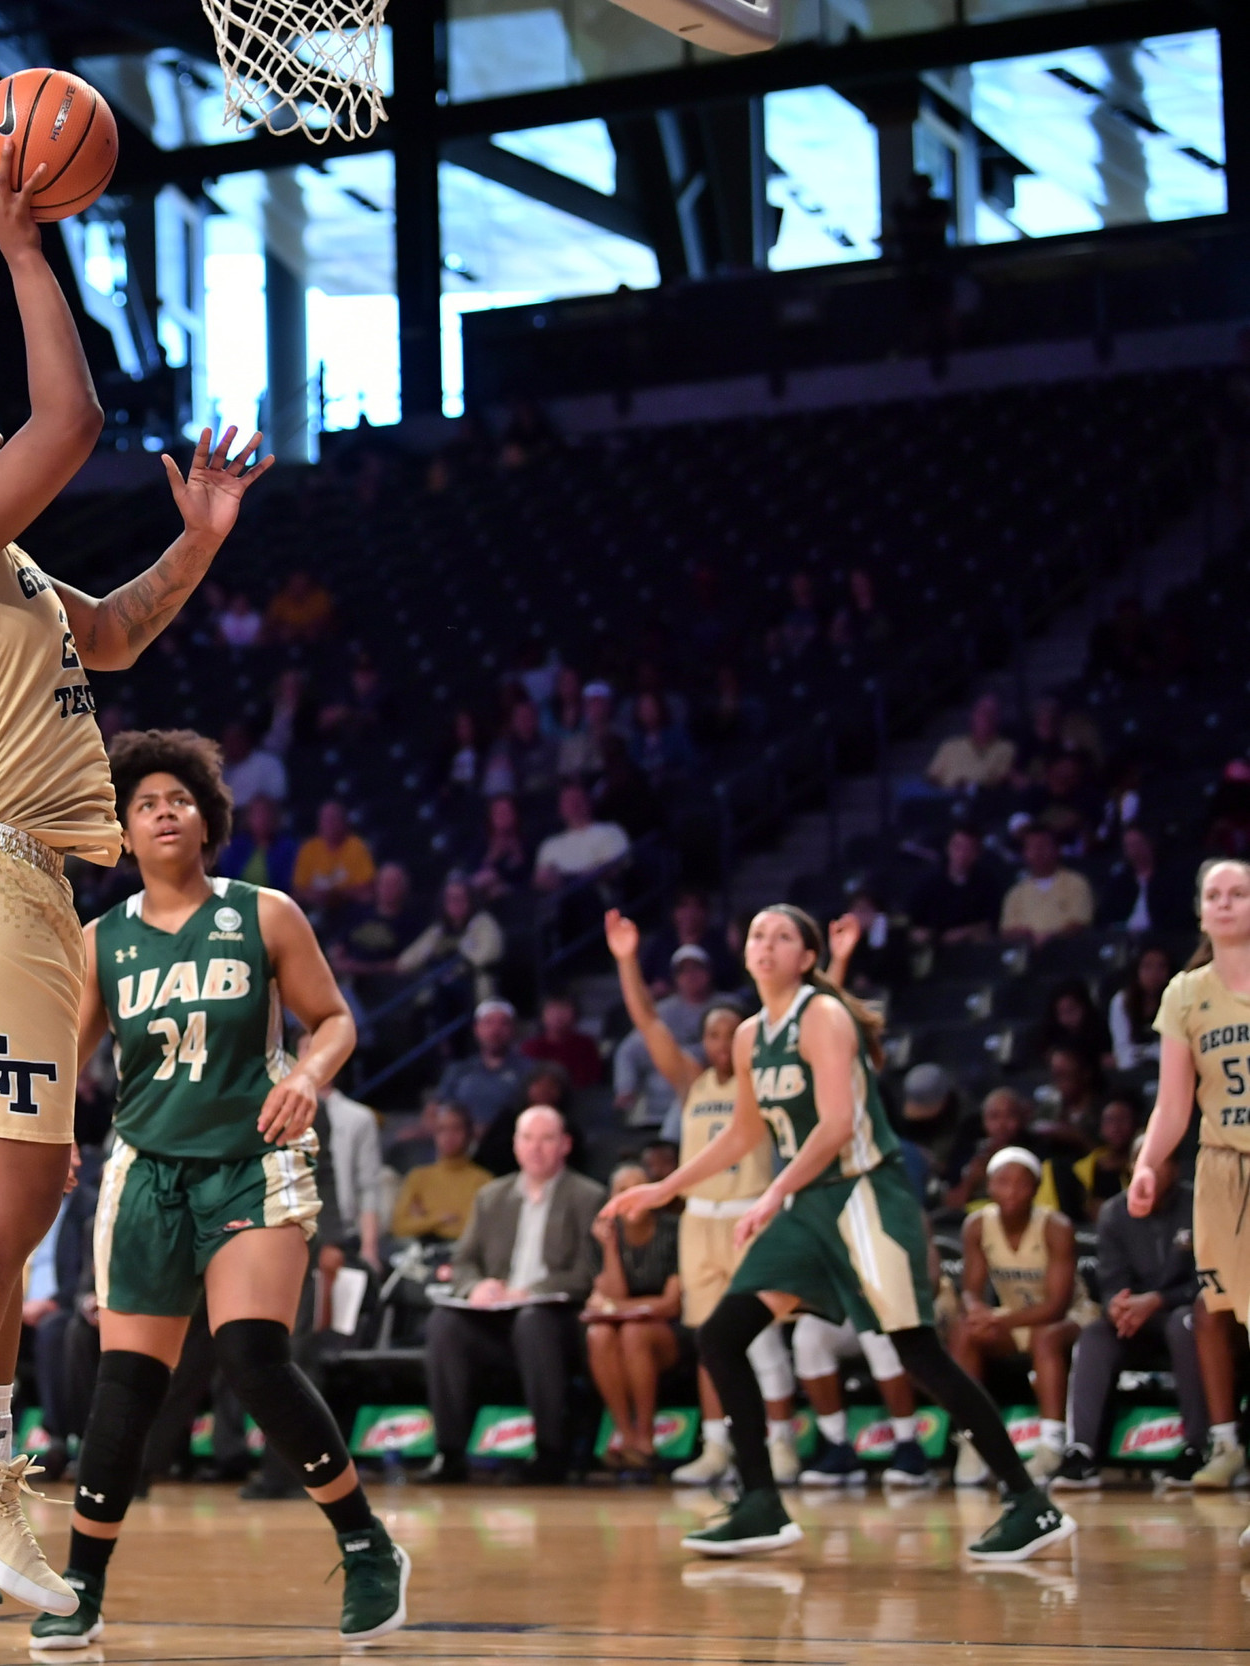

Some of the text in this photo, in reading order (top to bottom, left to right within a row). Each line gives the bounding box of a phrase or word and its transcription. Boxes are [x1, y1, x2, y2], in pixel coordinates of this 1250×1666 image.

[54, 684, 96, 718] TEC
[117, 958, 251, 1020] UAB
[146, 1011, 208, 1083] 34
